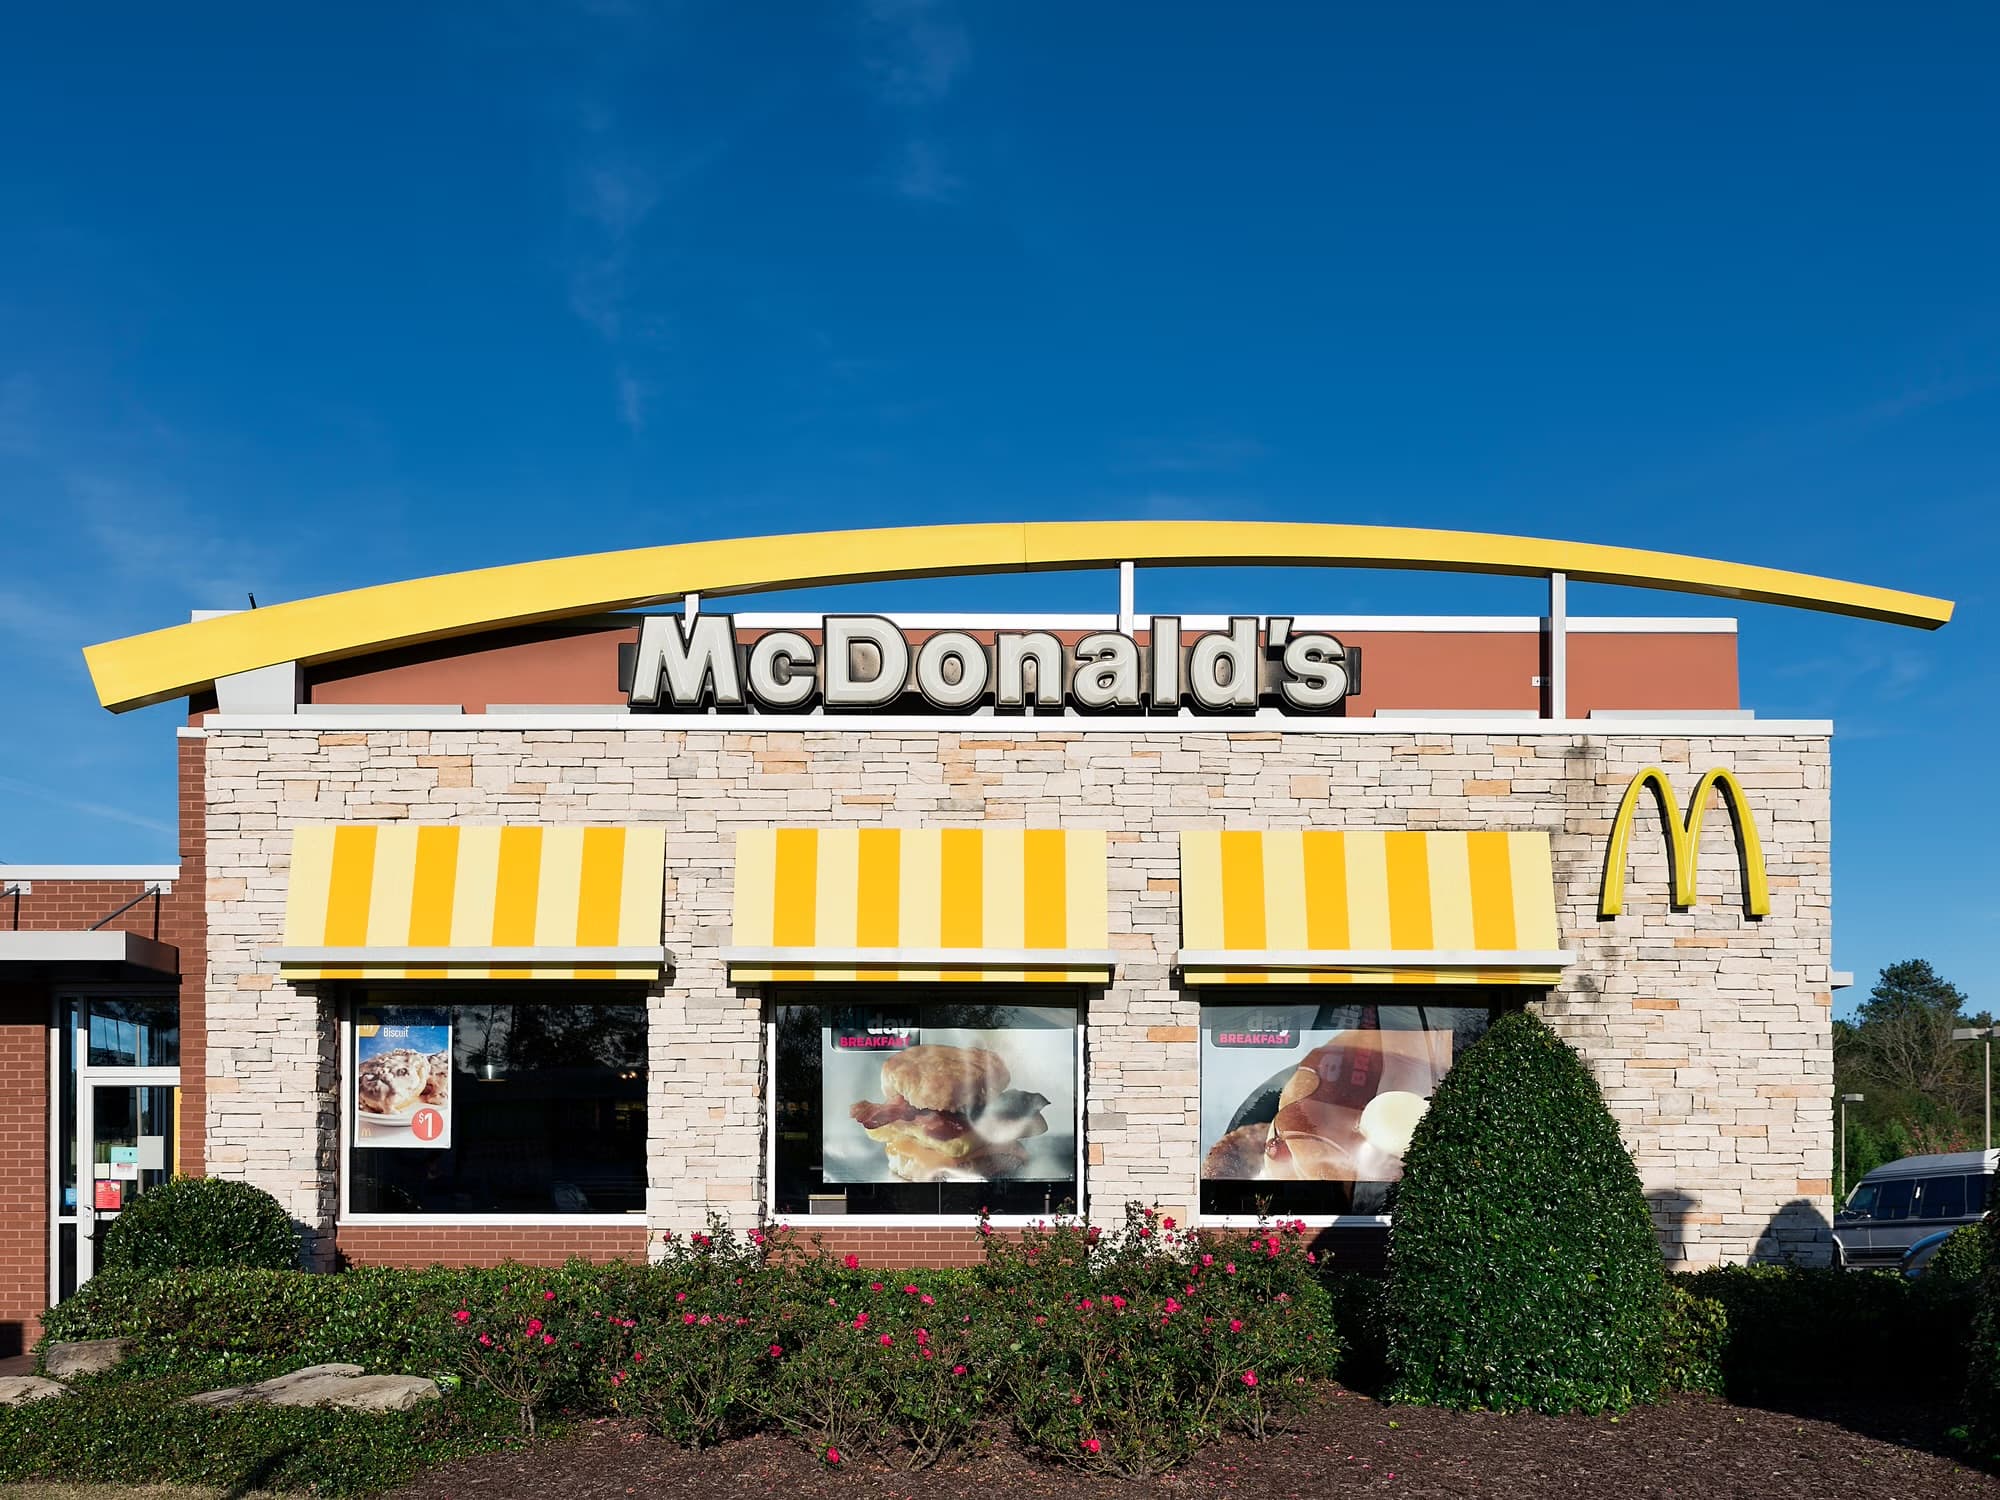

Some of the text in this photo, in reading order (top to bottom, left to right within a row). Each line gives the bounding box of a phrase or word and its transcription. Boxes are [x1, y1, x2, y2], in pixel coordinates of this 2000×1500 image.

[630, 613, 1349, 710] McDonald's
[383, 1027, 409, 1038] Biscuit
[867, 1011, 913, 1038] day
[1247, 1010, 1291, 1036] day
[839, 1036, 912, 1048] BREAKFAST
[1219, 1032, 1291, 1046] BREAKFAST
[418, 1112, 433, 1138] $1
